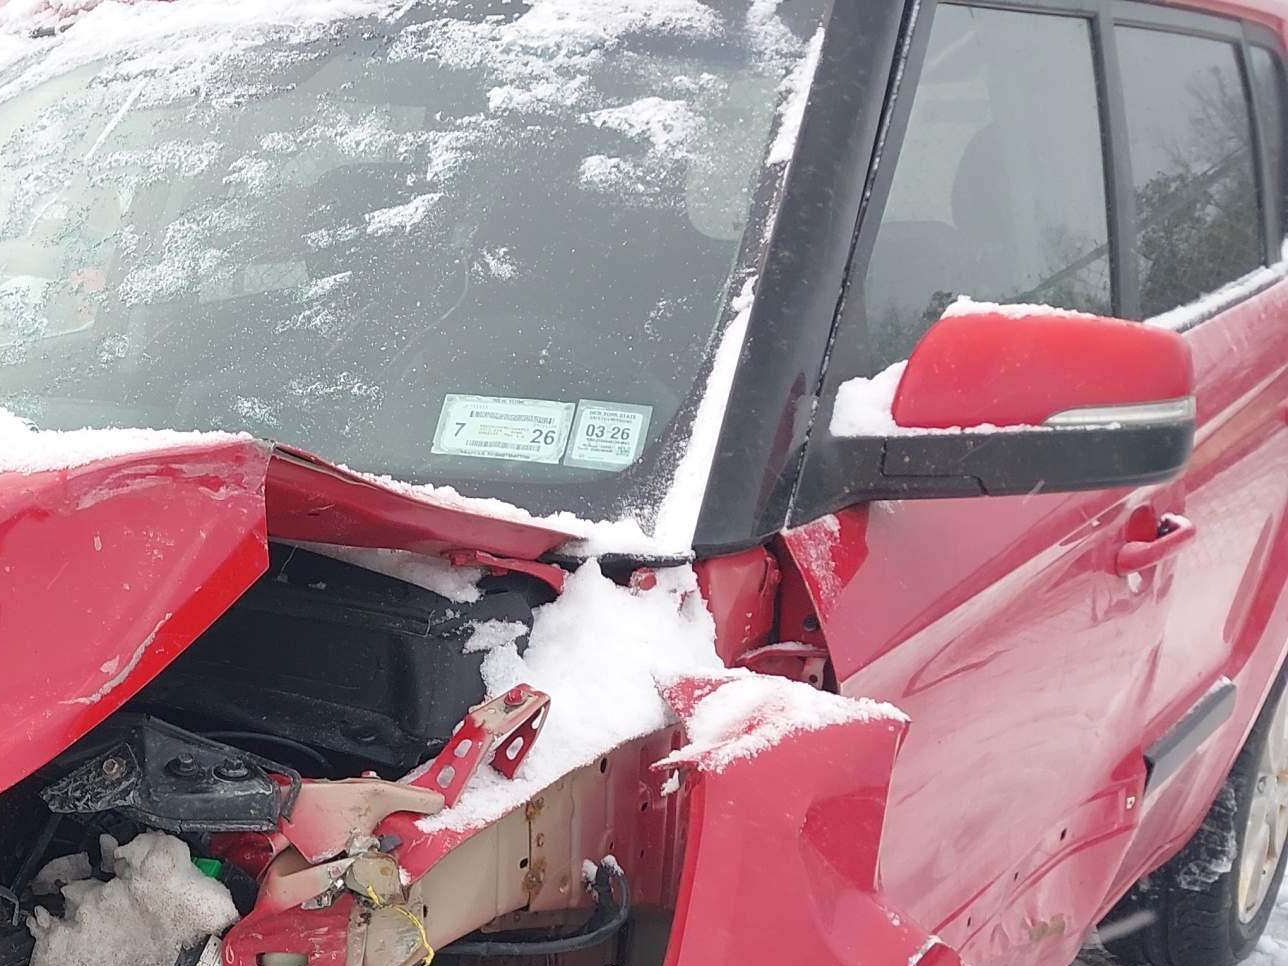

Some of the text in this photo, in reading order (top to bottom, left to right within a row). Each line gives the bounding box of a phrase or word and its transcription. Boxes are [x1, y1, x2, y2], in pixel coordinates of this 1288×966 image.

[453, 421, 468, 438] 7
[529, 428, 557, 446] 26
[585, 423, 606, 438] 03
[609, 426, 632, 441] 26
